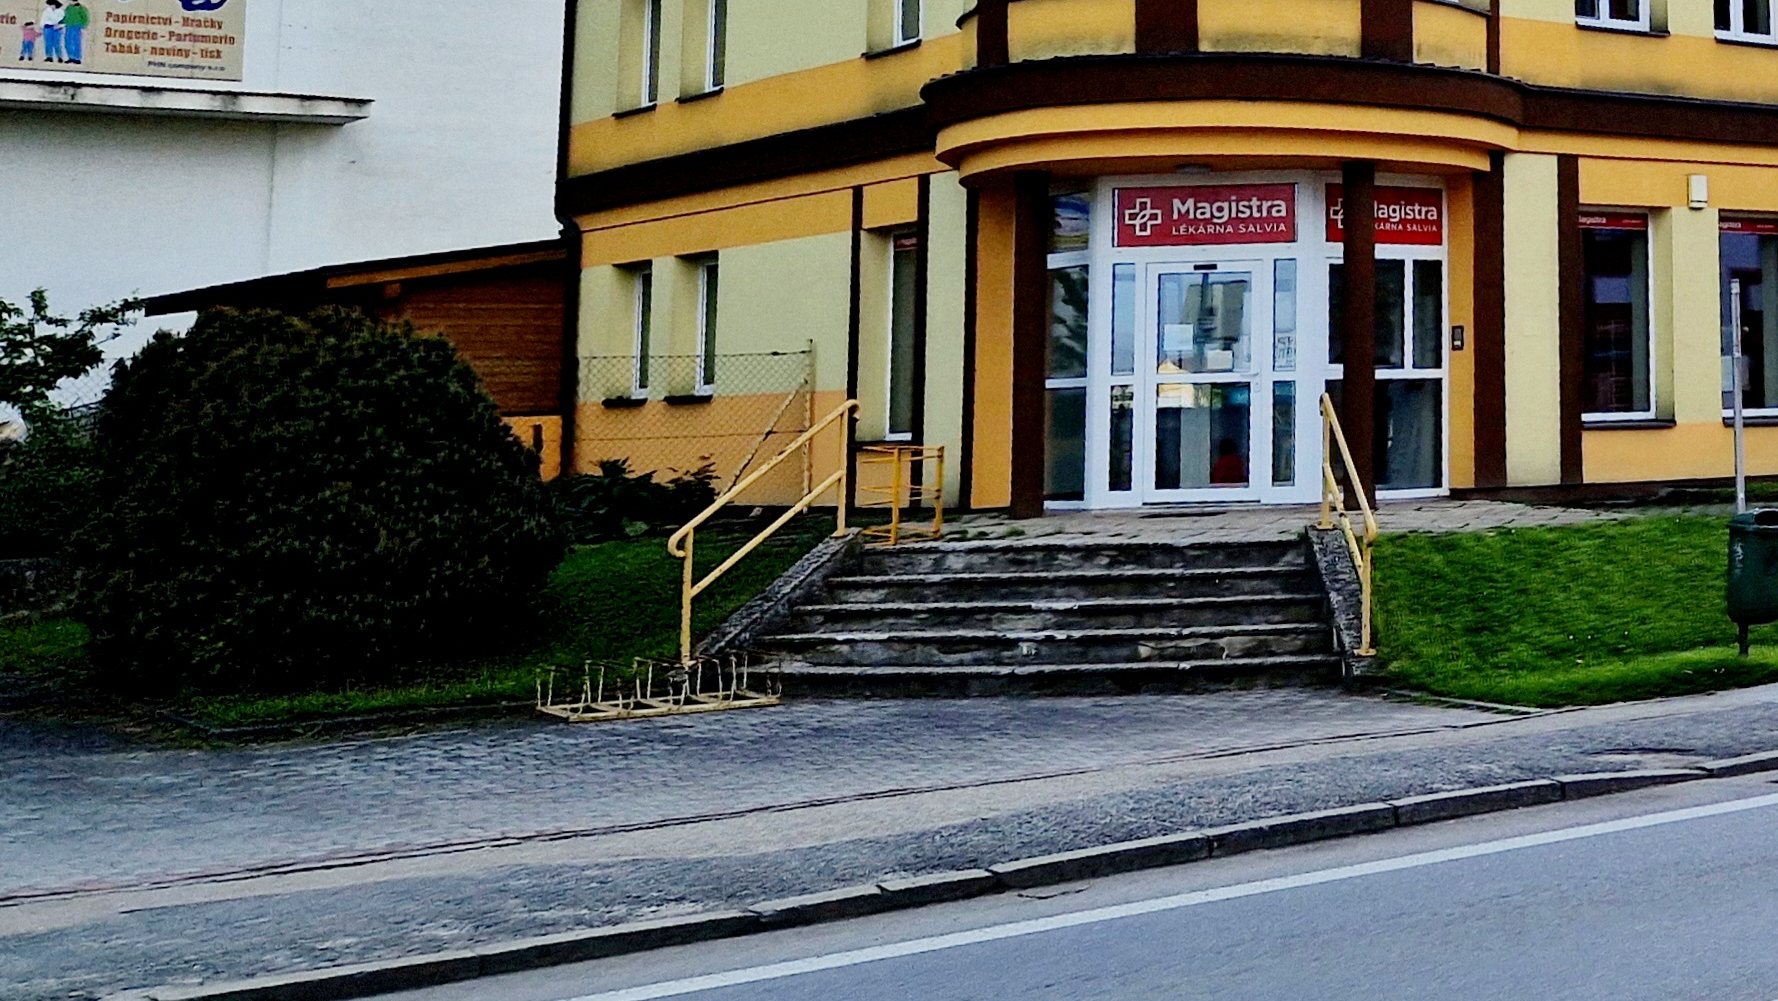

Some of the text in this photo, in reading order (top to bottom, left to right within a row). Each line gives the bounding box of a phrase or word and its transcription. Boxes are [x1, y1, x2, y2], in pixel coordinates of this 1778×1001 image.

[1172, 196, 1287, 223] Magistra
[1374, 200, 1438, 222] agistra
[1172, 222, 1287, 235] LÉKÁRNA SALVIA
[1406, 223, 1437, 232] SALVIA
